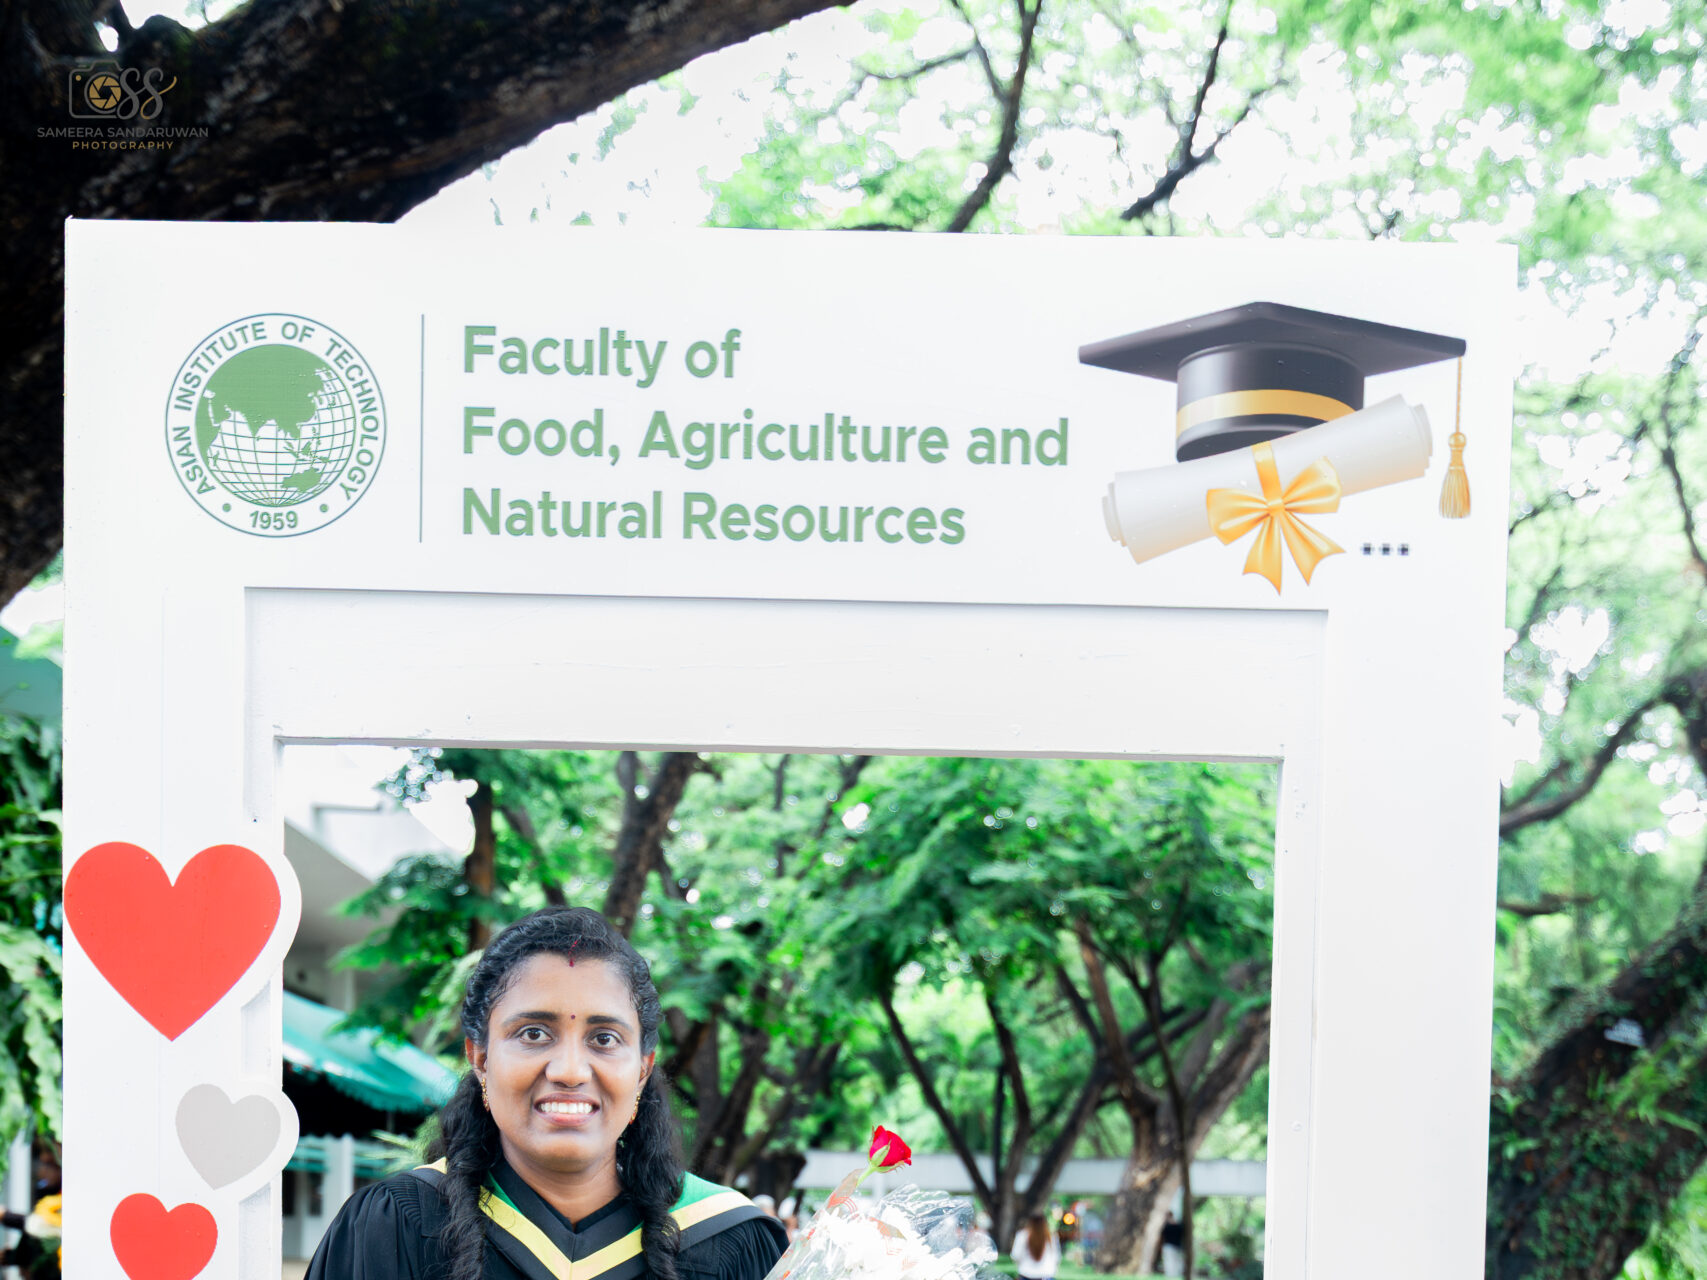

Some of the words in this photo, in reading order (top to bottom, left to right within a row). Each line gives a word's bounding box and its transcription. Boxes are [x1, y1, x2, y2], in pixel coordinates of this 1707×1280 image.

[281, 321, 316, 343] OF
[463, 325, 667, 389] Faculty
[684, 328, 742, 379] of
[174, 321, 267, 411] INSTITUTE
[325, 338, 380, 501] TECHNOLOGY
[463, 406, 621, 467] Food,
[638, 408, 950, 471] Agriculture
[966, 417, 1069, 467] and
[172, 425, 216, 496] ASIAN
[249, 510, 299, 531] 1959
[462, 487, 663, 540] Natural
[682, 491, 966, 546] Resources
